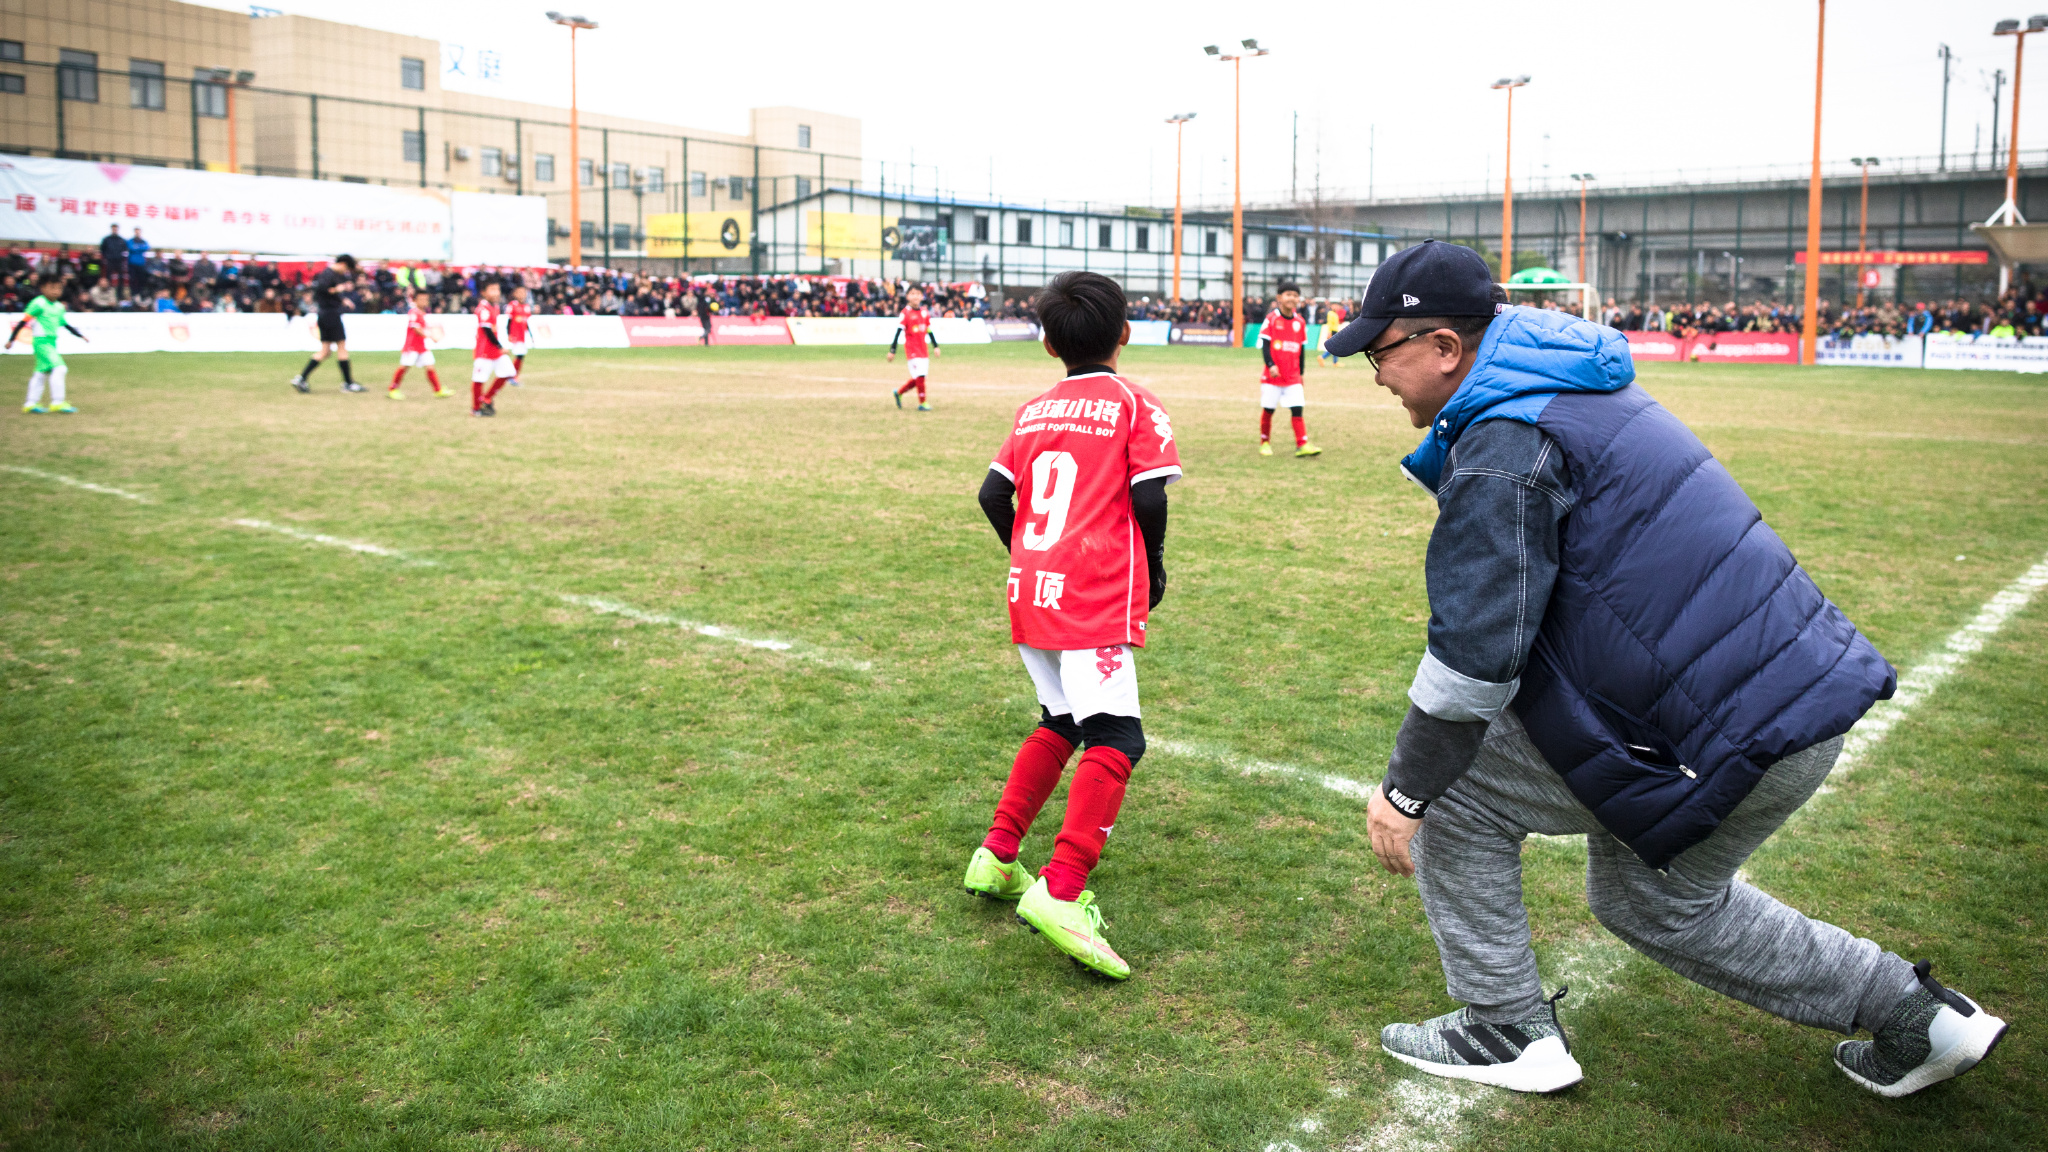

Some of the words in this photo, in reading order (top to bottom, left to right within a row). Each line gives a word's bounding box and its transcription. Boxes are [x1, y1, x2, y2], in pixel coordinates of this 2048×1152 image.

[1019, 399, 1121, 428] 足球小将
[1047, 423, 1093, 435] FOOTBALL
[1095, 427, 1116, 438] BOY
[1022, 451, 1078, 551] 9
[1388, 788, 1424, 815] NIKE
